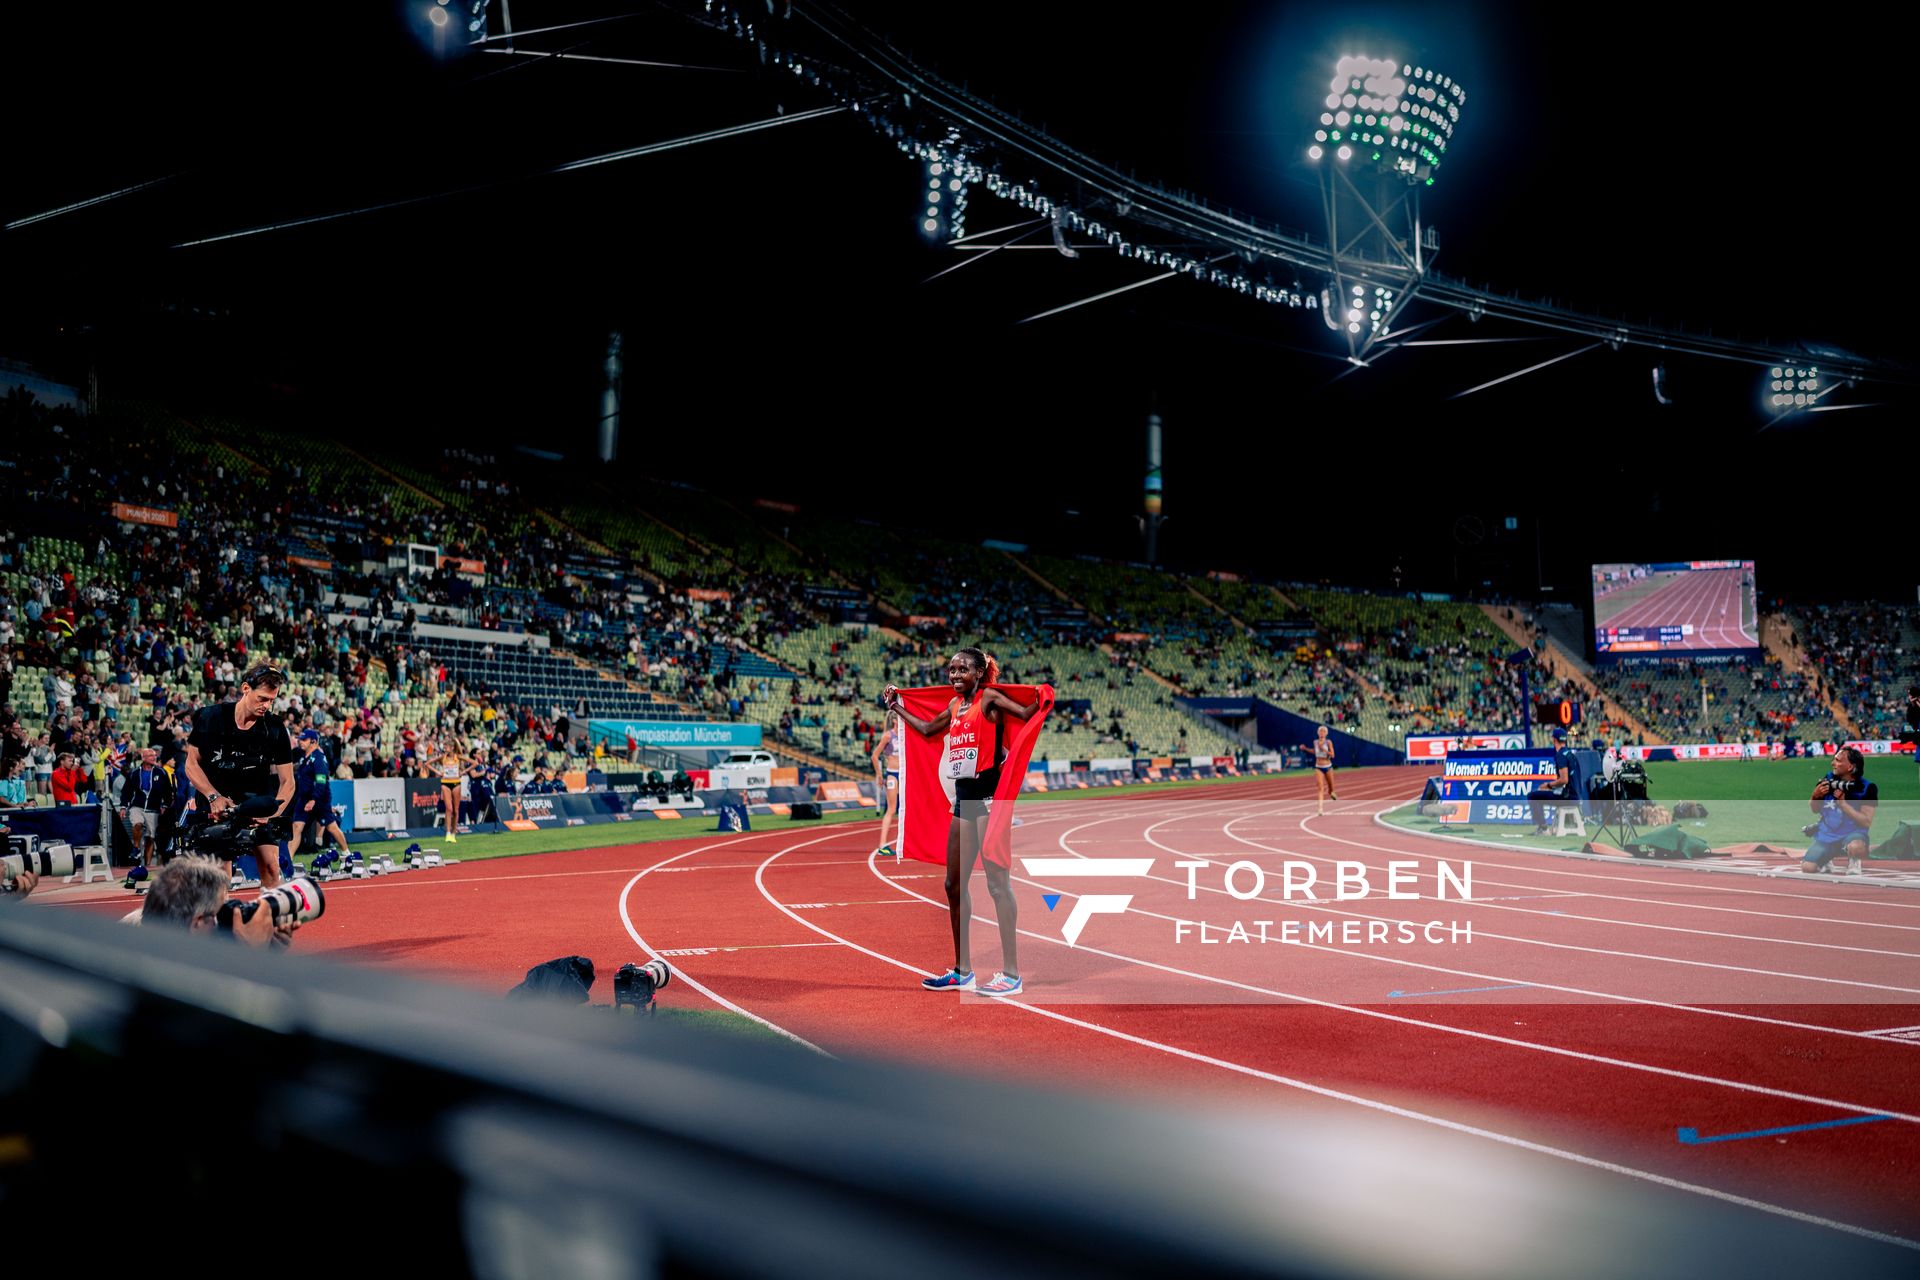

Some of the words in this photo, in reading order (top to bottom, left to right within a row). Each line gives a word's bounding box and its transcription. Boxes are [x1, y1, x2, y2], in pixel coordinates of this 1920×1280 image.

[1561, 701, 1572, 724] 0
[625, 724, 692, 744] Olympiastadion
[694, 727, 732, 742] München
[1445, 761, 1488, 776] Women's
[1492, 761, 1533, 775] 10000m
[1444, 782, 1451, 795] 1
[1465, 781, 1483, 796] Y.
[1488, 781, 1533, 796] CAN
[370, 798, 400, 816] REGUPOL
